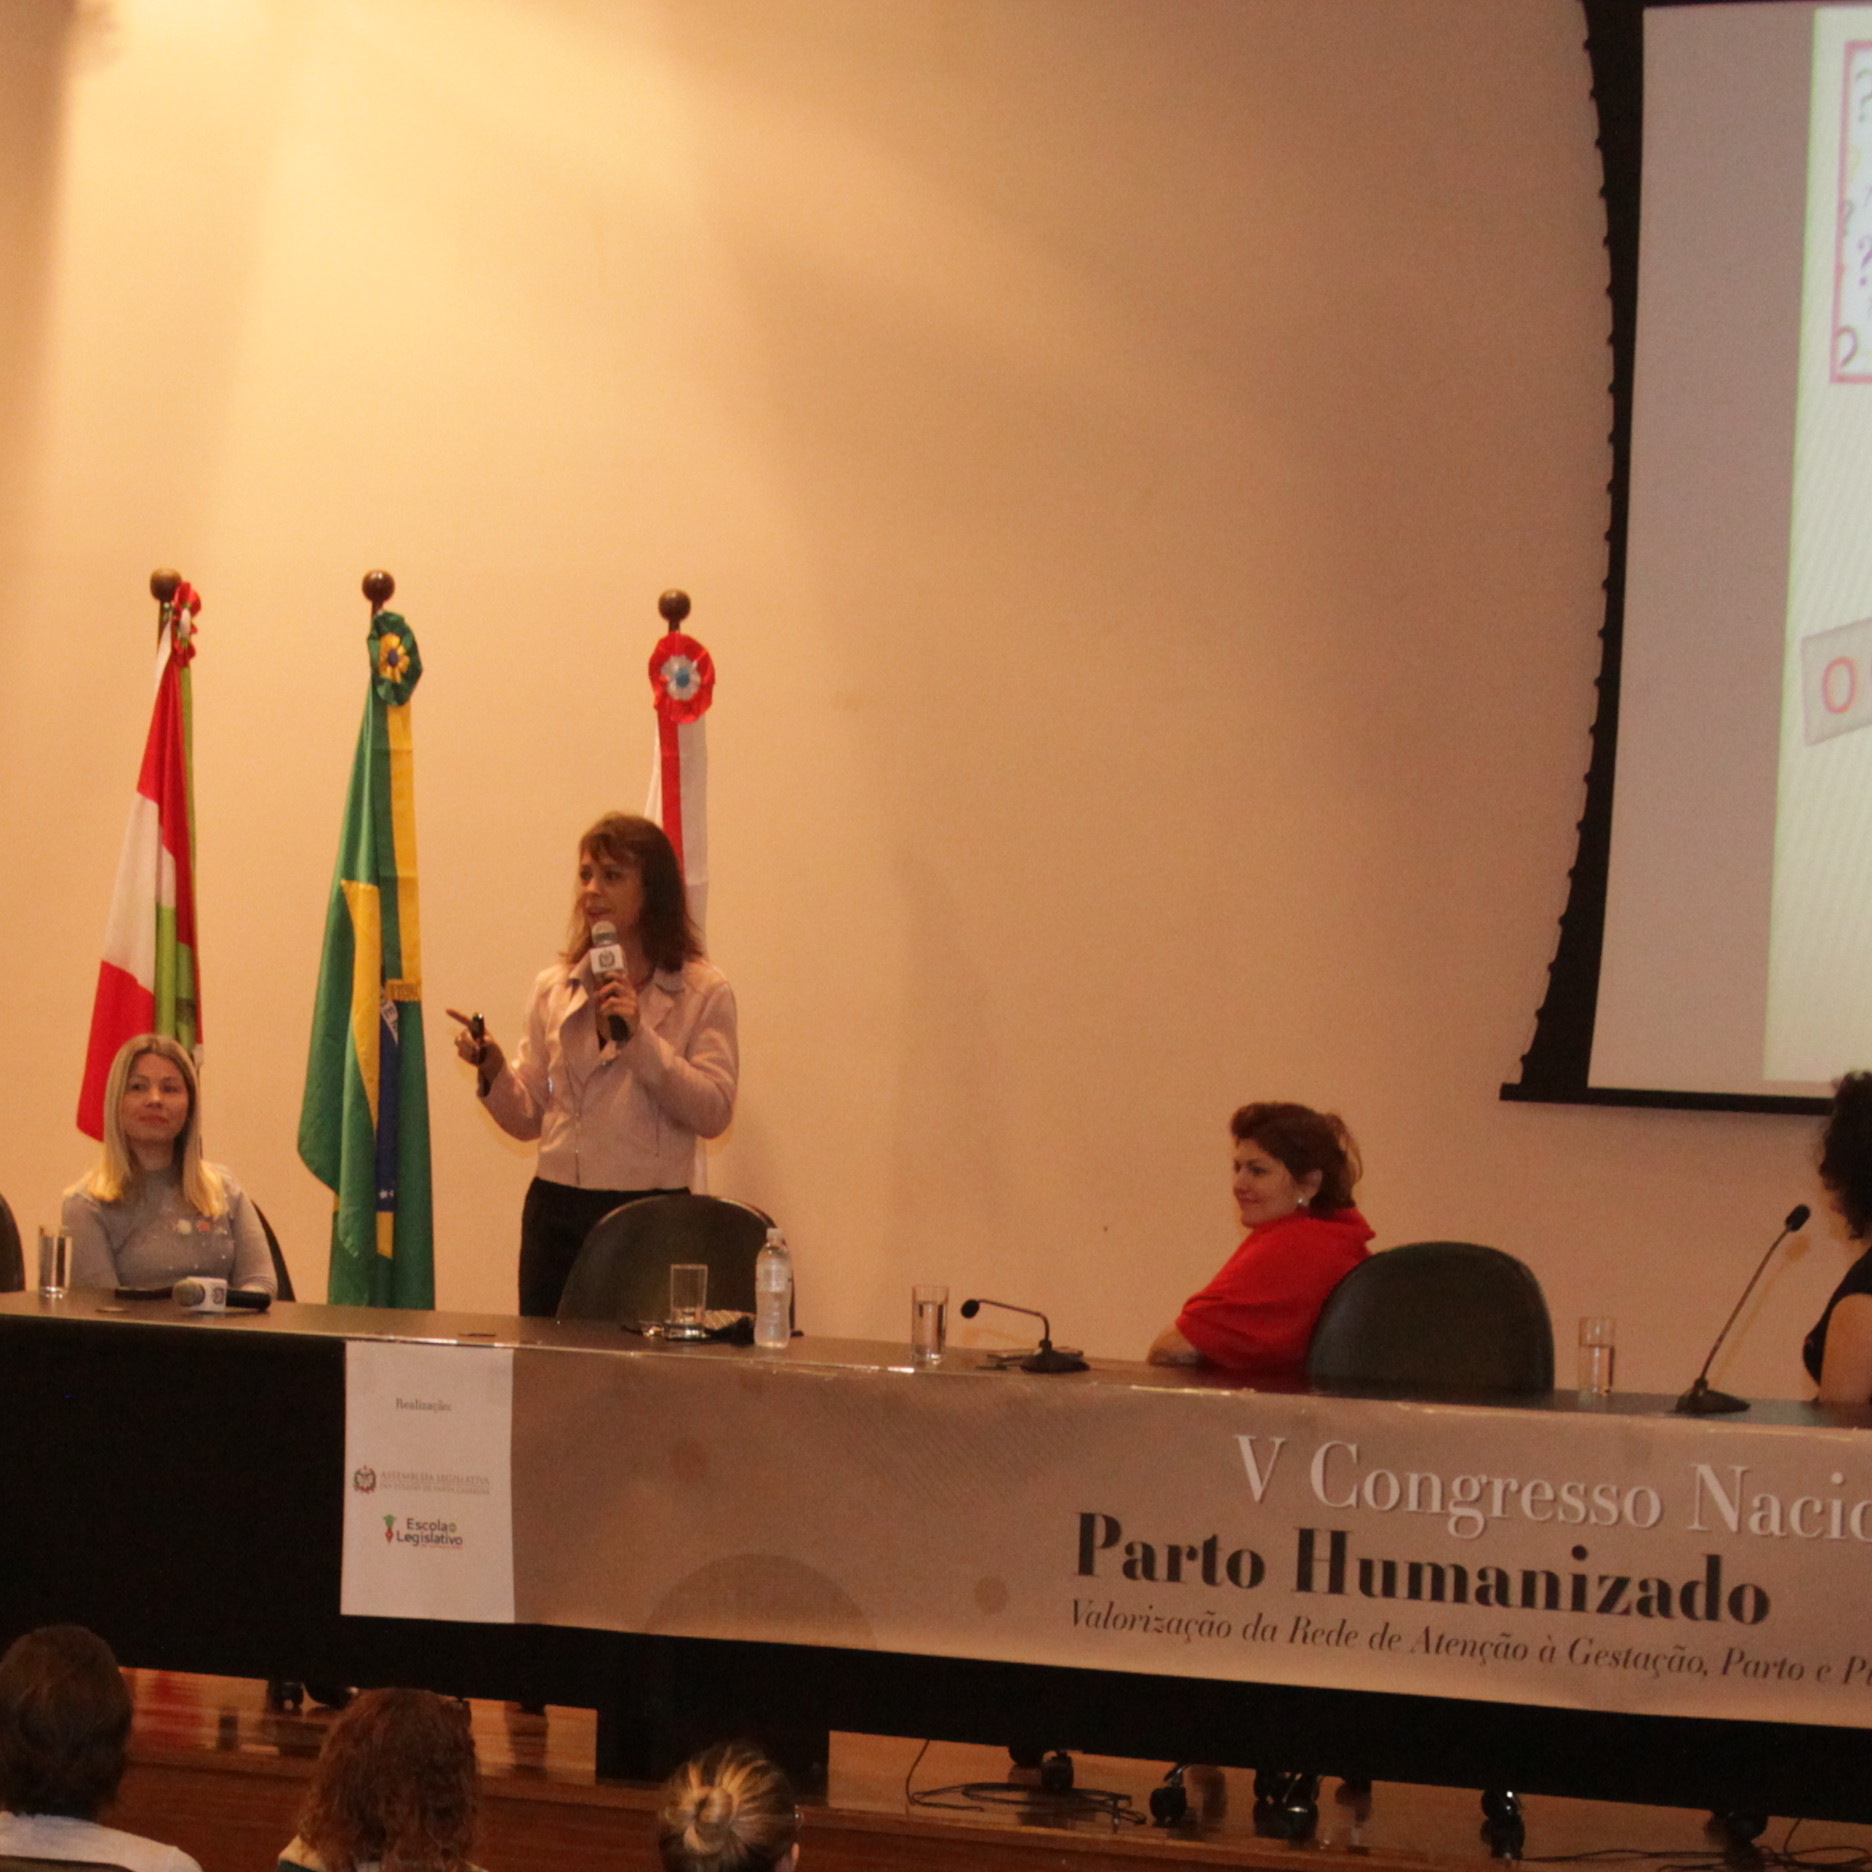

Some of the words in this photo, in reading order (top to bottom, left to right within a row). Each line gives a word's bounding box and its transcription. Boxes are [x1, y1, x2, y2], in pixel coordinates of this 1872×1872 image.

[1822, 656, 1858, 715] O
[1234, 1434, 1286, 1502] V
[1310, 1440, 1663, 1540] Congresso
[396, 1530, 463, 1546] Legislativo
[406, 1518, 448, 1532] Escola
[1077, 1511, 1266, 1590] Parto
[1292, 1527, 1772, 1625] Humanizado
[1070, 1599, 1232, 1644] Valorização
[1242, 1612, 1278, 1644] da
[1288, 1615, 1359, 1649] Rede
[1368, 1621, 1402, 1652] de
[1410, 1625, 1528, 1665] Atenção
[1538, 1635, 1557, 1664] à
[1568, 1636, 1710, 1680] Gestação,
[1721, 1647, 1805, 1682] Parto
[1815, 1664, 1831, 1684] e
